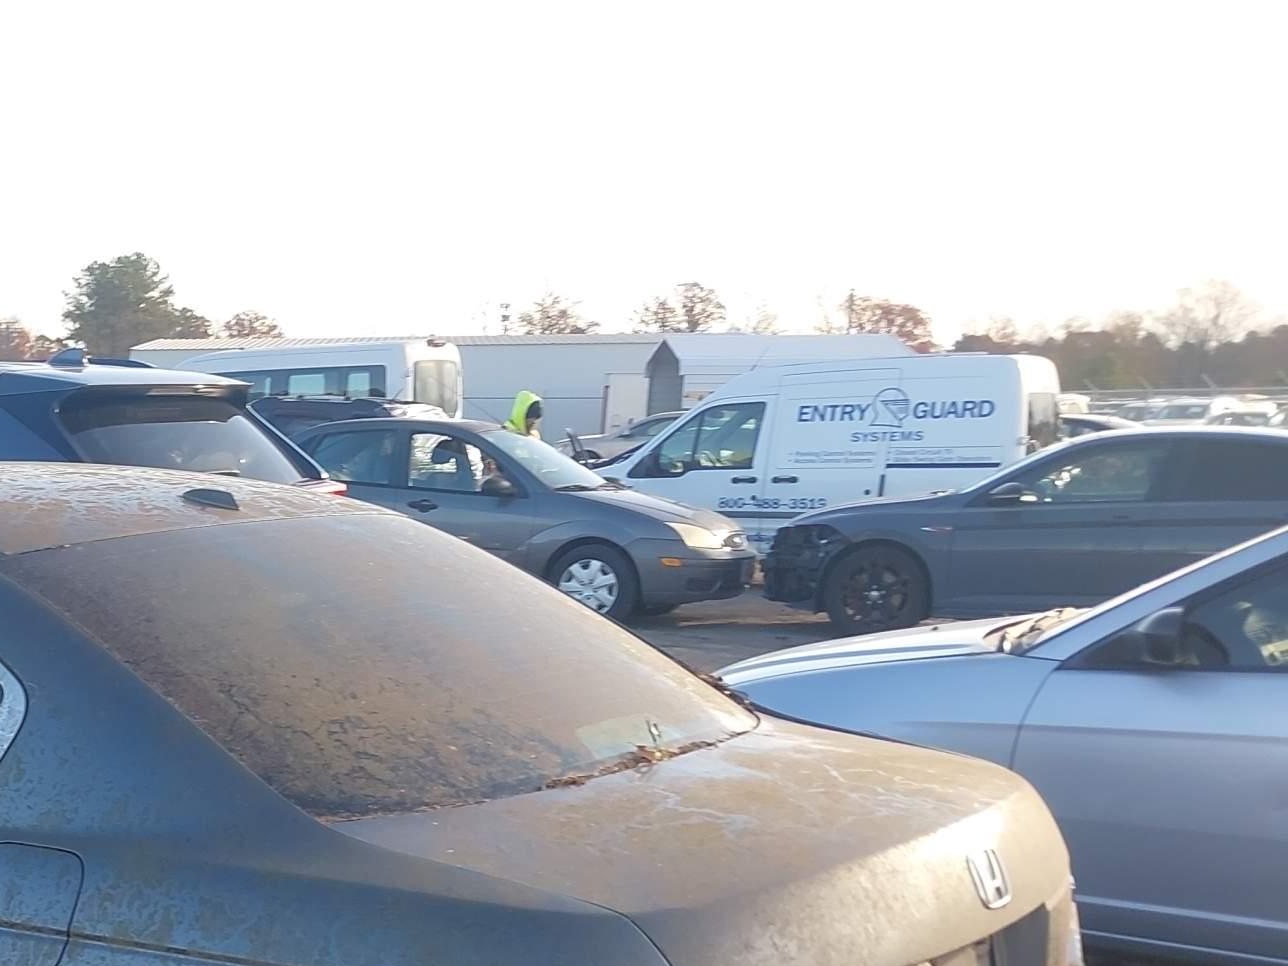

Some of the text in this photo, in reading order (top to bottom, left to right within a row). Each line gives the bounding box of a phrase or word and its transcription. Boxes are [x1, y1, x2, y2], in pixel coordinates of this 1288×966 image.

[797, 400, 996, 423] ENTRY GUARD
[850, 431, 925, 443] SYSTEMS
